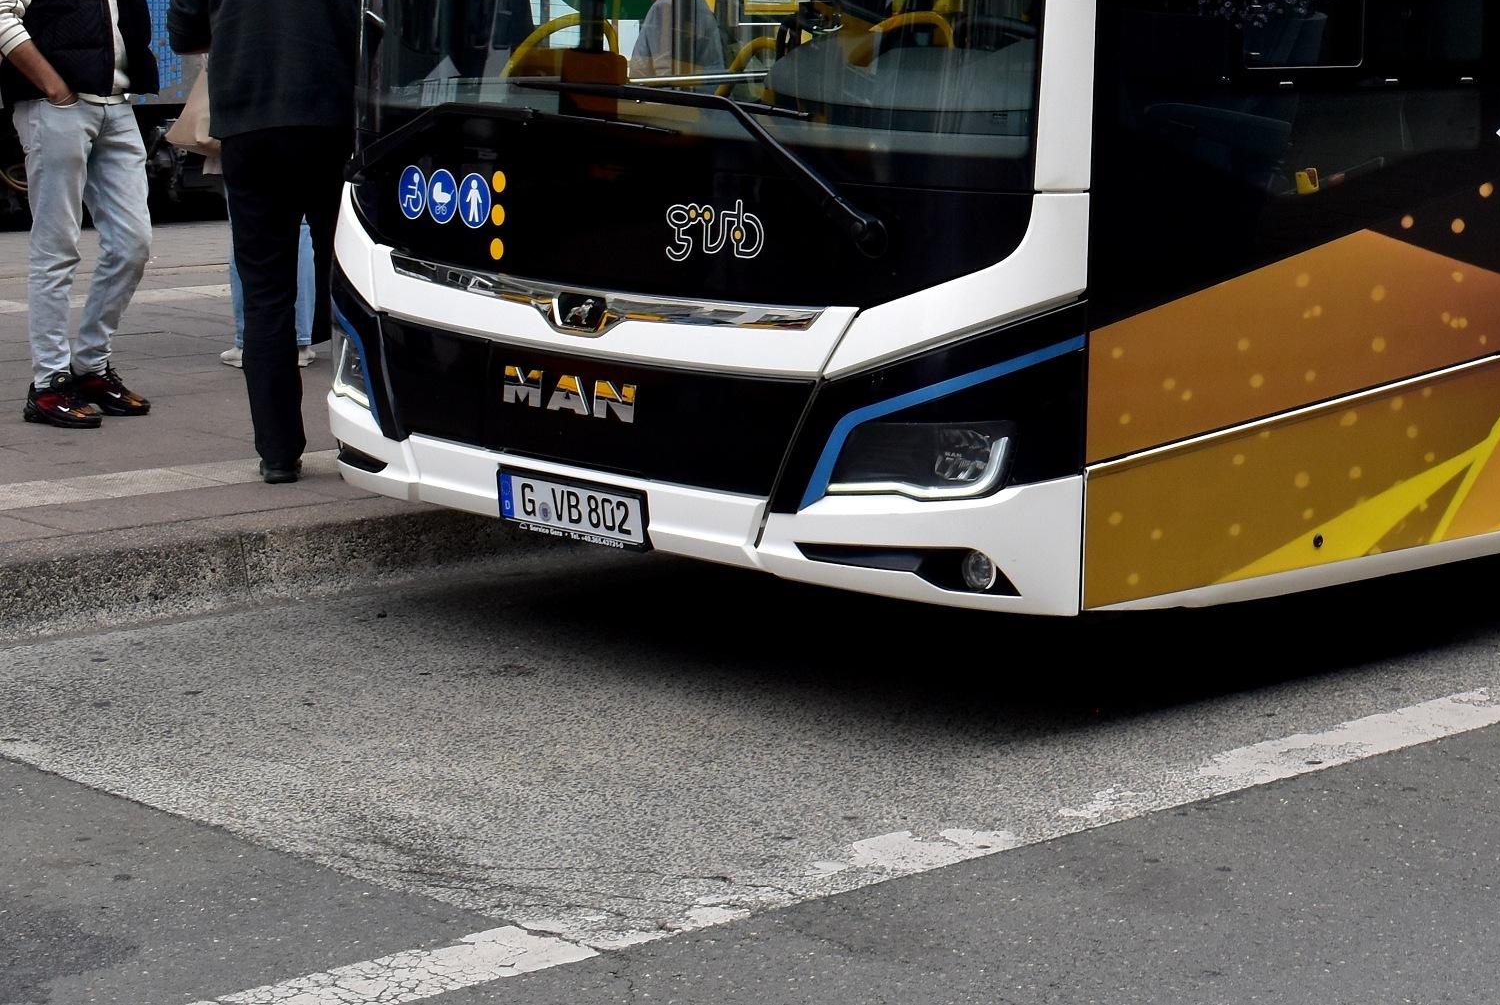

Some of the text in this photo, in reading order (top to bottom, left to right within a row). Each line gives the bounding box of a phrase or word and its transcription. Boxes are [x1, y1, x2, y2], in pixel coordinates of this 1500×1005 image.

[503, 365, 637, 423] MAN
[521, 482, 631, 536] G VB 802
[529, 524, 549, 535] Service
[550, 528, 563, 537] Gera
